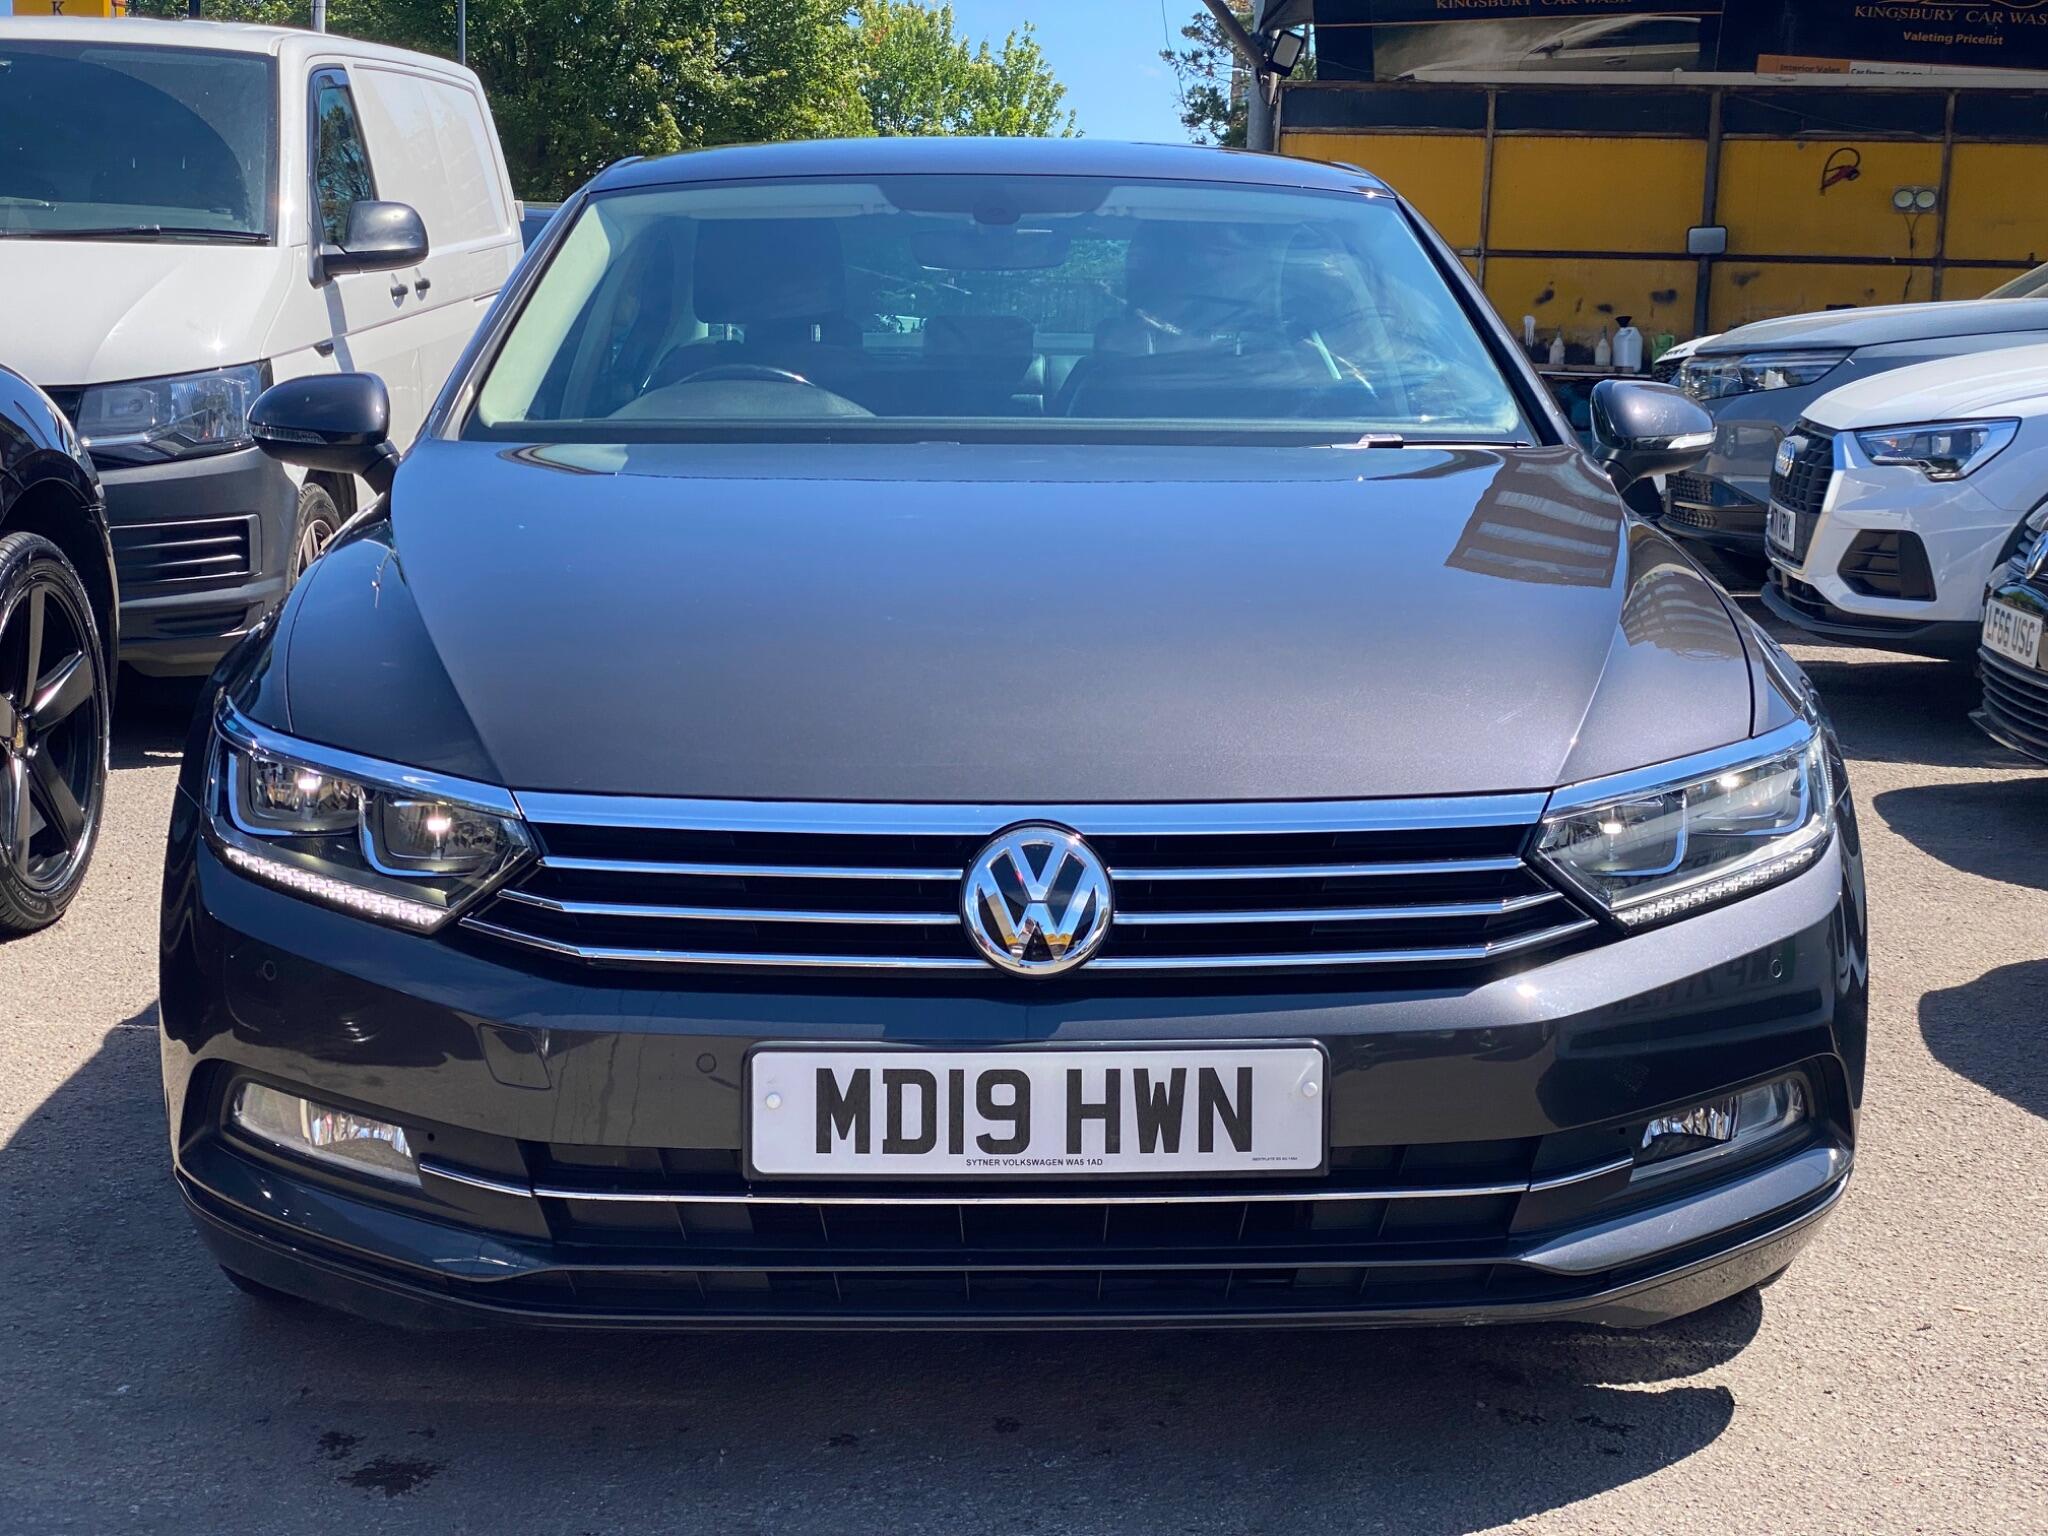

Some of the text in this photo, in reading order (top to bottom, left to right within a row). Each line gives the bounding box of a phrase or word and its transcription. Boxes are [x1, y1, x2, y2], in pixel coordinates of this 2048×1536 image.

[1855, 5, 1958, 21] KINGSBURY
[1966, 10, 2003, 23] CAR
[1903, 31, 2003, 46] Valeting Pricelist
[815, 1066, 1253, 1155] MD19 HWN
[966, 1158, 1103, 1167] SYTNER VOLKSWAGEN WA5 1AD
